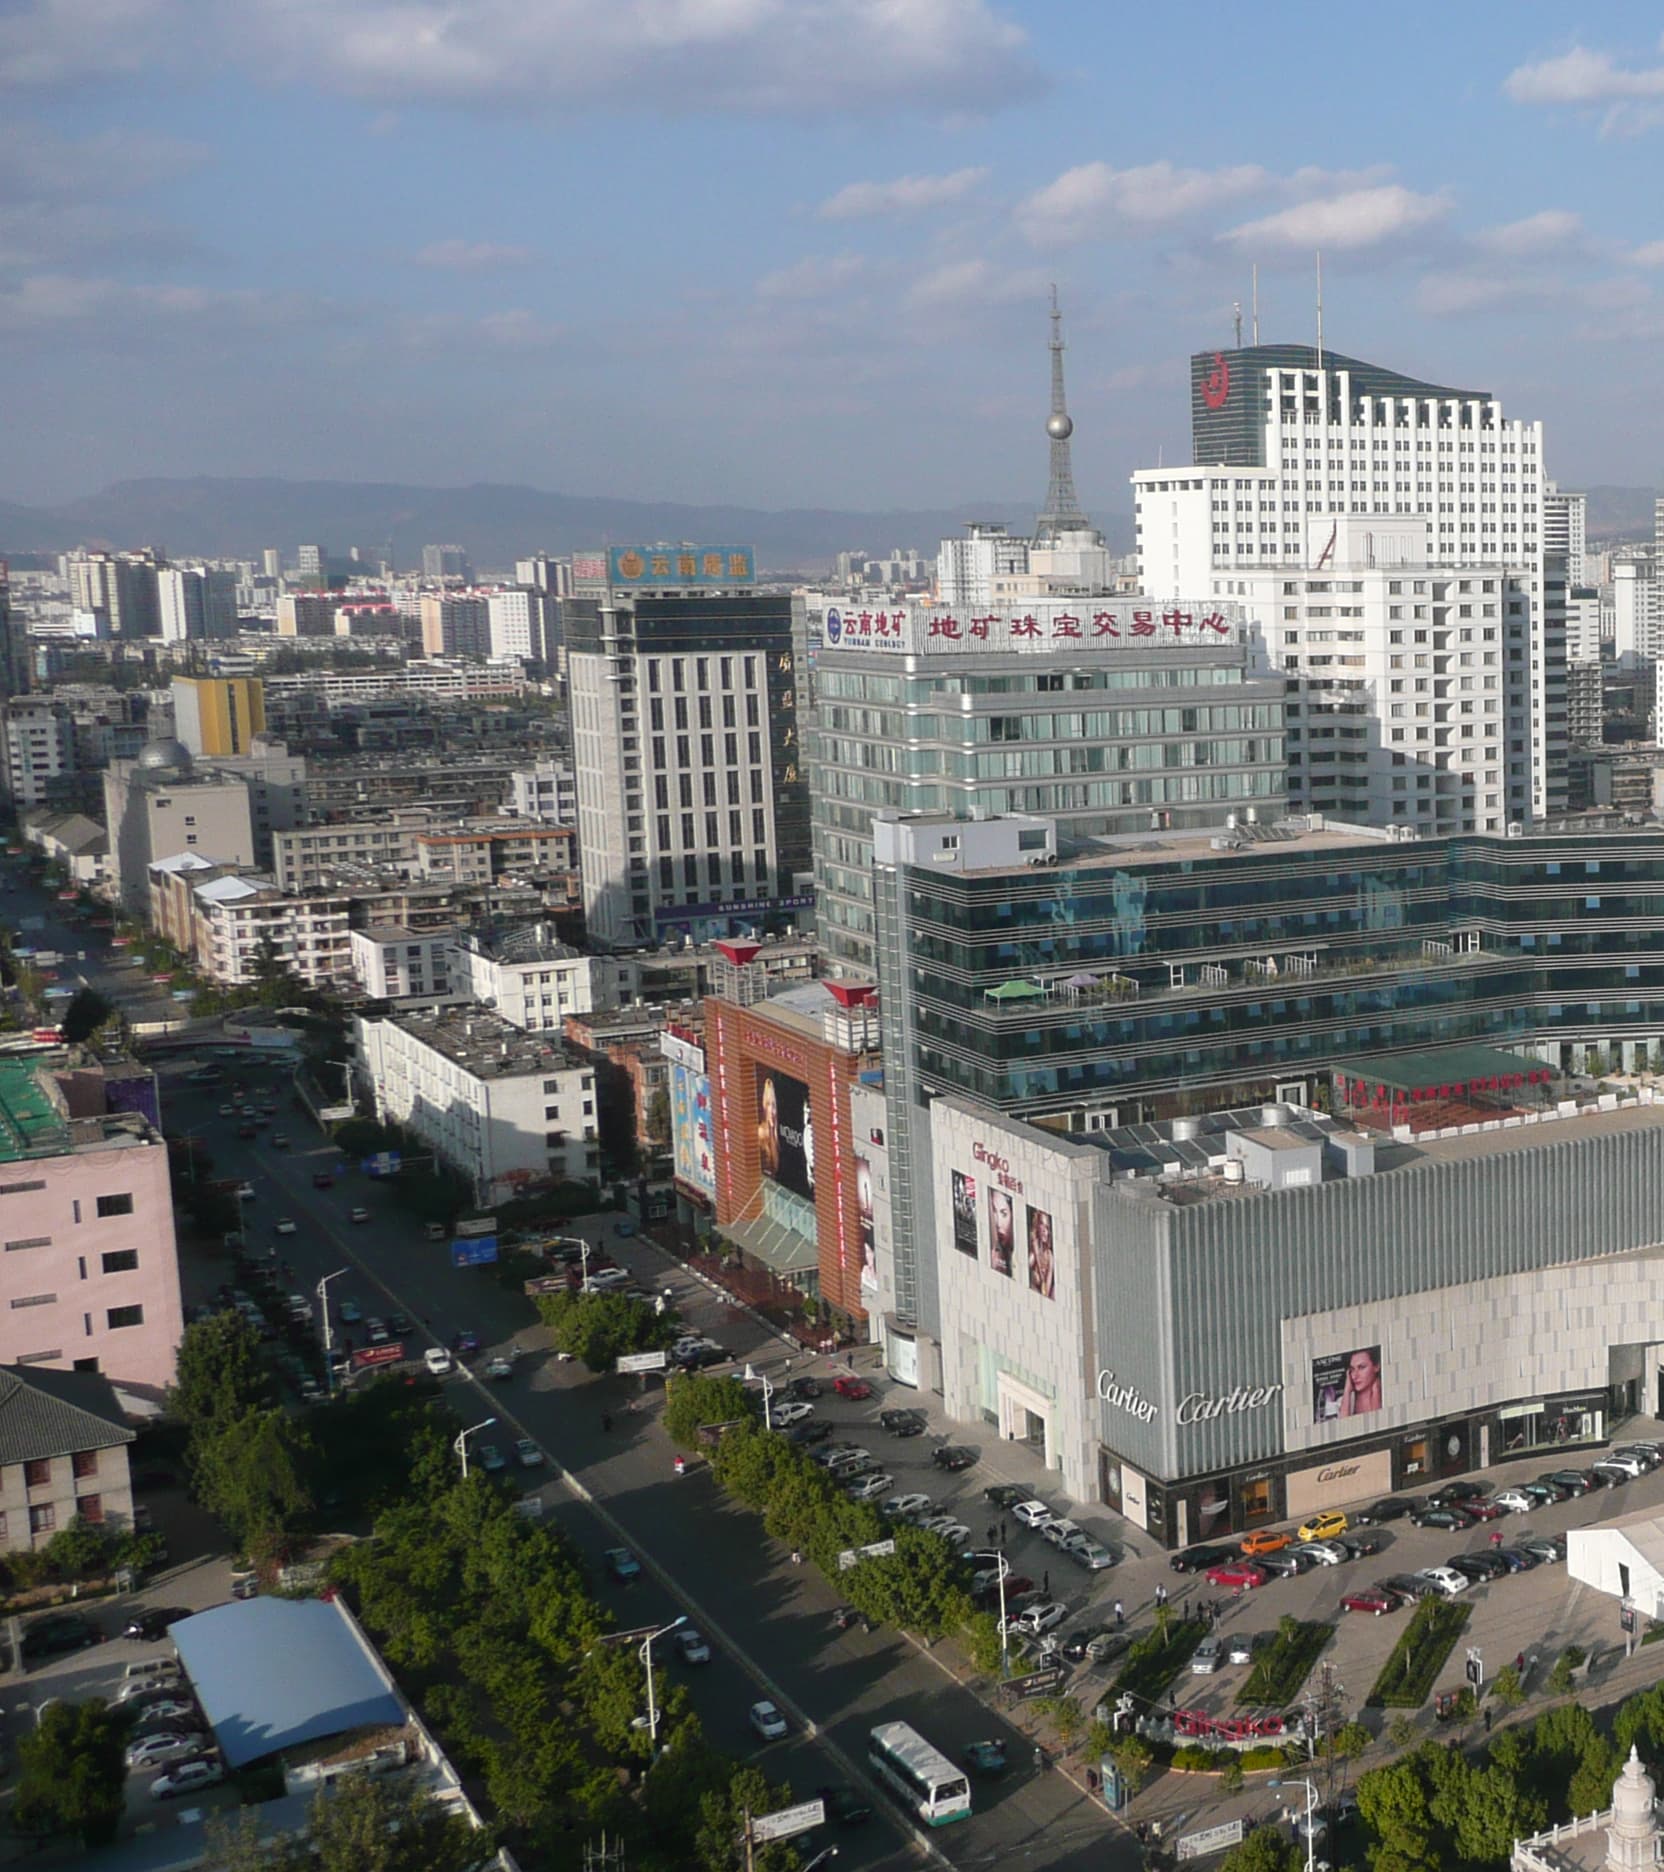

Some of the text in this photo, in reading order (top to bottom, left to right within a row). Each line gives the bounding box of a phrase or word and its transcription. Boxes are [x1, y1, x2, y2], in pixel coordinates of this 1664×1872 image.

[843, 610, 906, 637] 云南地矿
[928, 609, 1230, 640] 地矿珠宝交易中心
[718, 901, 771, 912] SUNSHINE
[972, 1141, 1010, 1173] Gingko
[1097, 1369, 1158, 1423] Cartier
[1176, 1384, 1282, 1425] Cartier
[1316, 1463, 1361, 1484] Cartier
[1174, 1709, 1284, 1741] Gingko
